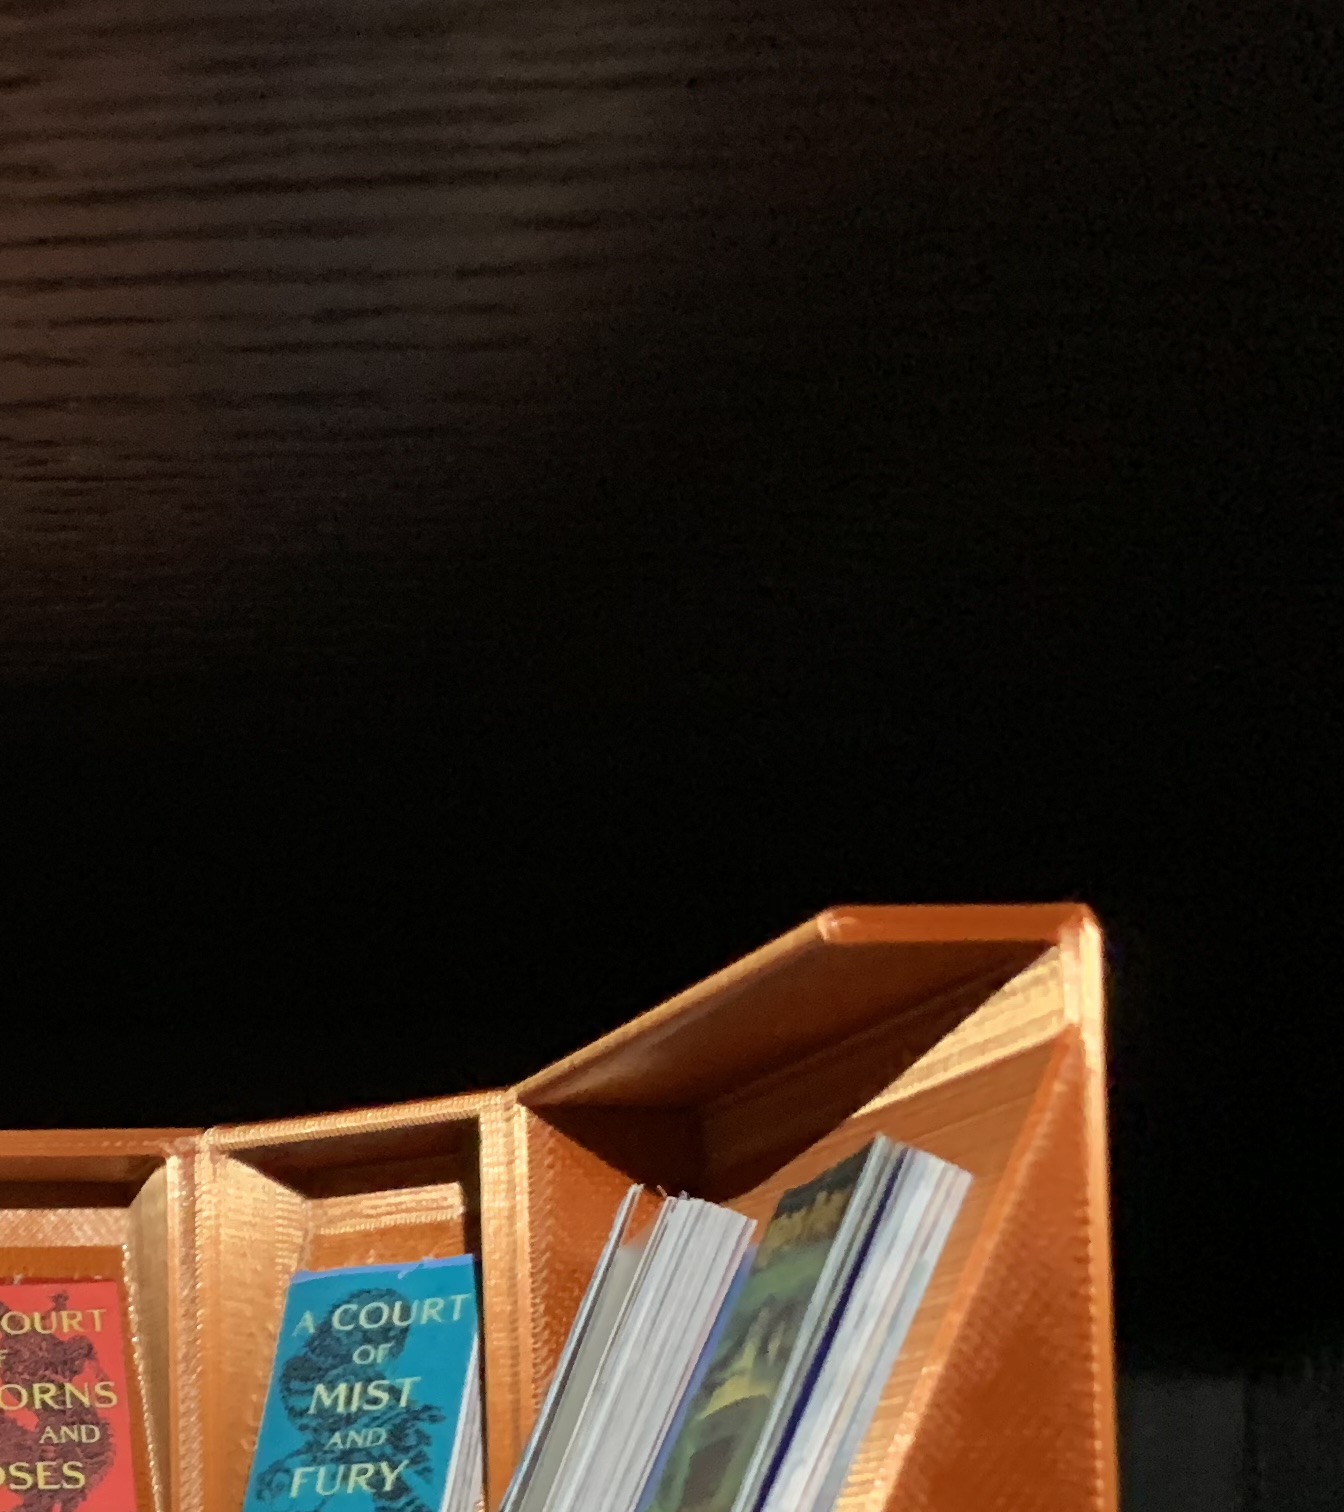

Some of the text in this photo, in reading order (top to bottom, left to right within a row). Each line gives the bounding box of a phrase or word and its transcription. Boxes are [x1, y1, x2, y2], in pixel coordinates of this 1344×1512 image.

[292, 1293, 472, 1336] A COURT
[352, 1342, 395, 1366] OF
[307, 1376, 422, 1415] MIST
[39, 1424, 101, 1444] AND
[323, 1427, 388, 1450] AND
[289, 1459, 410, 1499] FURY
